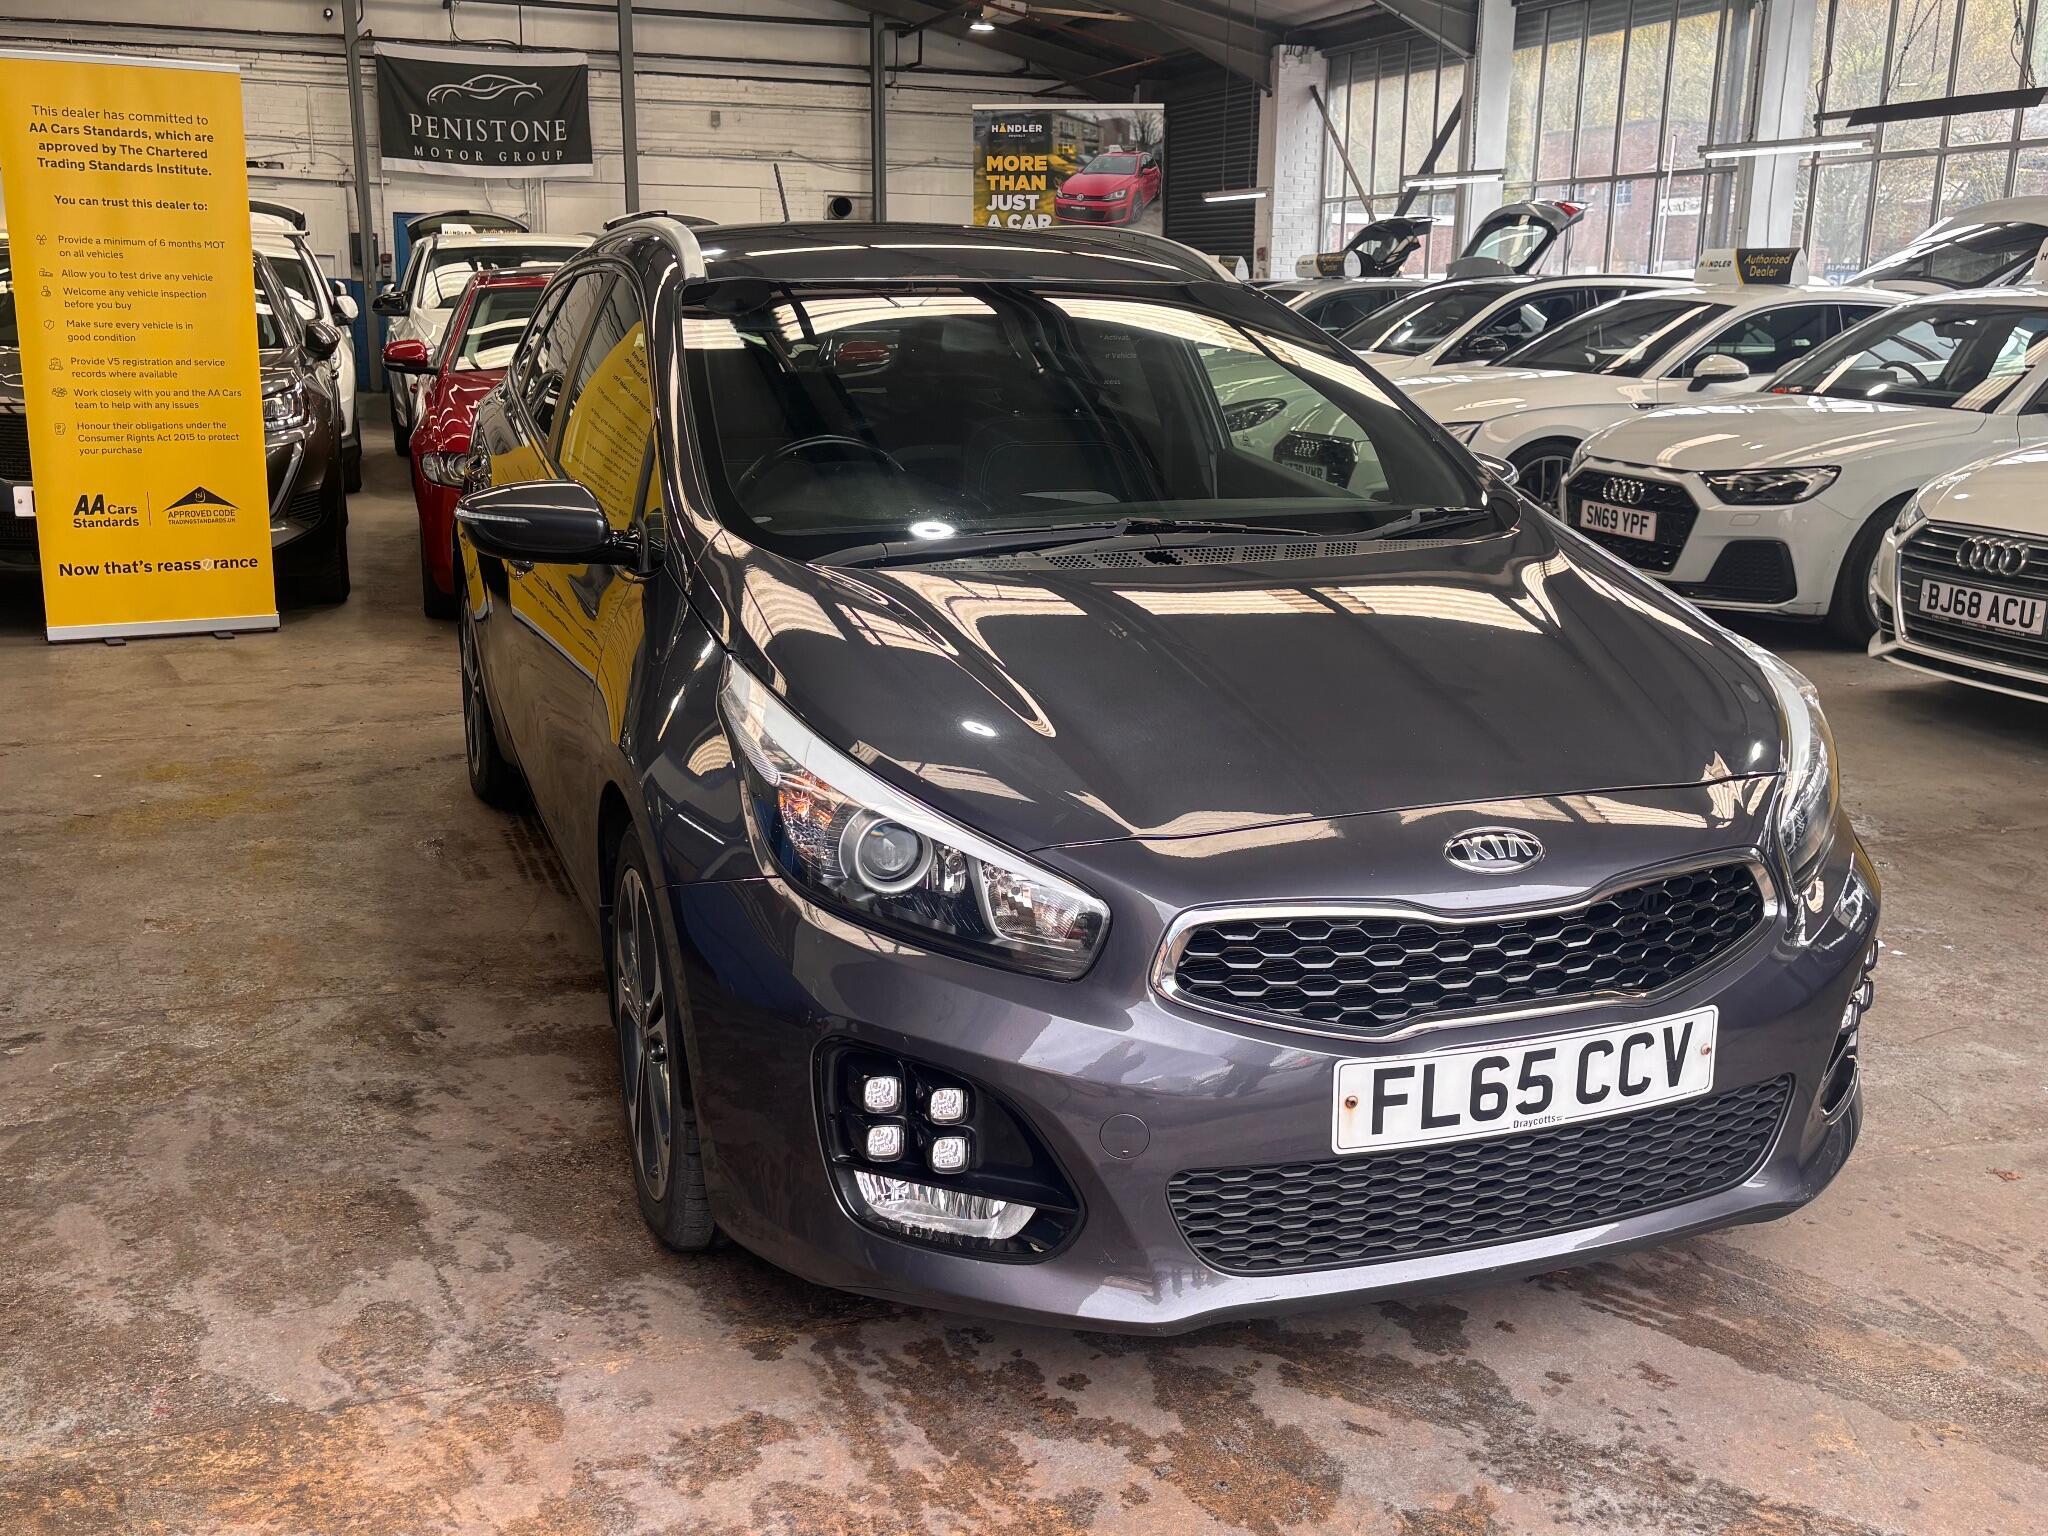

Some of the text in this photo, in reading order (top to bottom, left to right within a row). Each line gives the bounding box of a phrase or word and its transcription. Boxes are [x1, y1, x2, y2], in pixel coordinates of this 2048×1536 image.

[32, 105, 208, 126] This dealer has committed to
[29, 122, 214, 142] AA Cars Standards, which are
[409, 113, 567, 142] PENISTONE
[38, 141, 208, 158] approved by The Chartered
[414, 145, 563, 162] MOTOR GROUP
[37, 157, 212, 176] Trading Standards Institute.
[986, 155, 1048, 172] MORE
[986, 175, 1046, 191] THAN
[54, 194, 208, 211] You can trust this dealer to:
[986, 194, 1039, 211] JUST
[987, 214, 1051, 229] A CAR
[58, 236, 93, 245] Provide
[104, 238, 146, 246] minimum
[148, 238, 157, 247] of
[160, 239, 166, 247] 6
[168, 239, 201, 248] months
[204, 241, 225, 249] MOT
[74, 249, 84, 258] all
[87, 250, 124, 259] vehicles
[1744, 253, 1792, 265] Authorised
[61, 269, 87, 278] Allow
[89, 272, 105, 280] you
[120, 271, 137, 279] test
[140, 271, 162, 280] drive
[164, 273, 180, 282] any
[182, 272, 213, 281] vehicle
[1750, 266, 1778, 277] Dealer
[63, 287, 207, 299] Welcome any vehicle inspection
[64, 300, 132, 310] before you buy
[66, 320, 91, 328] Make
[115, 322, 140, 330] every
[142, 321, 173, 330] vehicle
[176, 321, 183, 330] is
[185, 321, 193, 330] in
[67, 333, 136, 343] good condition
[71, 357, 225, 368] Provide V5 registration and service
[72, 370, 178, 378] records where available
[74, 389, 98, 397] Work
[100, 389, 132, 398] closely
[134, 388, 153, 397] with
[173, 388, 189, 397] and
[192, 388, 206, 397] the
[208, 389, 220, 397] AA
[222, 389, 242, 397] Cars
[100, 401, 109, 409] to
[111, 400, 131, 410] help
[133, 400, 152, 409] with
[154, 403, 170, 411] any
[172, 401, 199, 409] issues
[77, 421, 226, 431] Honour their obligations under the
[78, 434, 124, 443] Consumer
[127, 434, 154, 444] Rights
[157, 434, 172, 442] Act
[174, 433, 195, 441] 2015
[208, 433, 240, 442] protect
[79, 446, 142, 456] your purchase
[74, 494, 138, 515] AA Cars
[168, 510, 212, 518] APPROVED
[1586, 505, 1649, 535] SN69 YPF
[73, 517, 139, 528] Standards
[59, 563, 99, 576] Now
[104, 560, 152, 574] that's
[1927, 583, 2036, 628] BJ68 ACU
[1459, 834, 1533, 862] KIA
[1371, 1022, 1694, 1135] FL65 CCV
[1513, 1115, 1556, 1129] Draycotts
